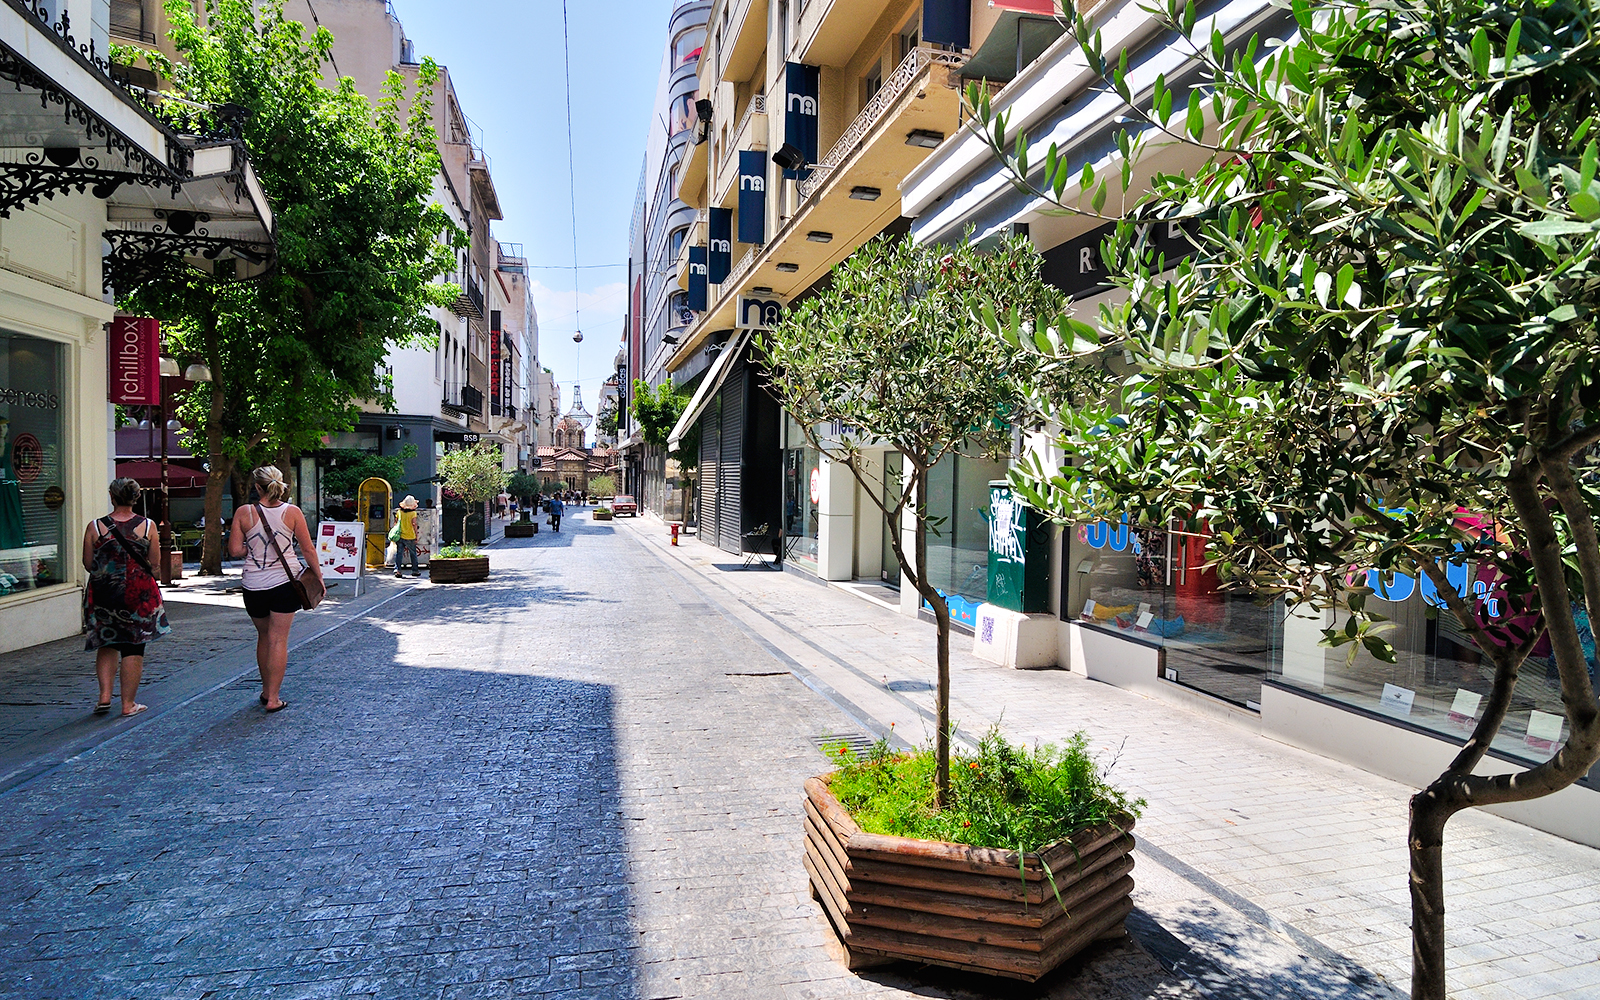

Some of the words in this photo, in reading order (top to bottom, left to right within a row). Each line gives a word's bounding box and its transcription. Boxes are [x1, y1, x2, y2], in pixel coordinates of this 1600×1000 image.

[119, 320, 139, 394] chillbox
[490, 330, 501, 355] Foot
[490, 358, 501, 397] Locker
[463, 434, 478, 442] BSB
